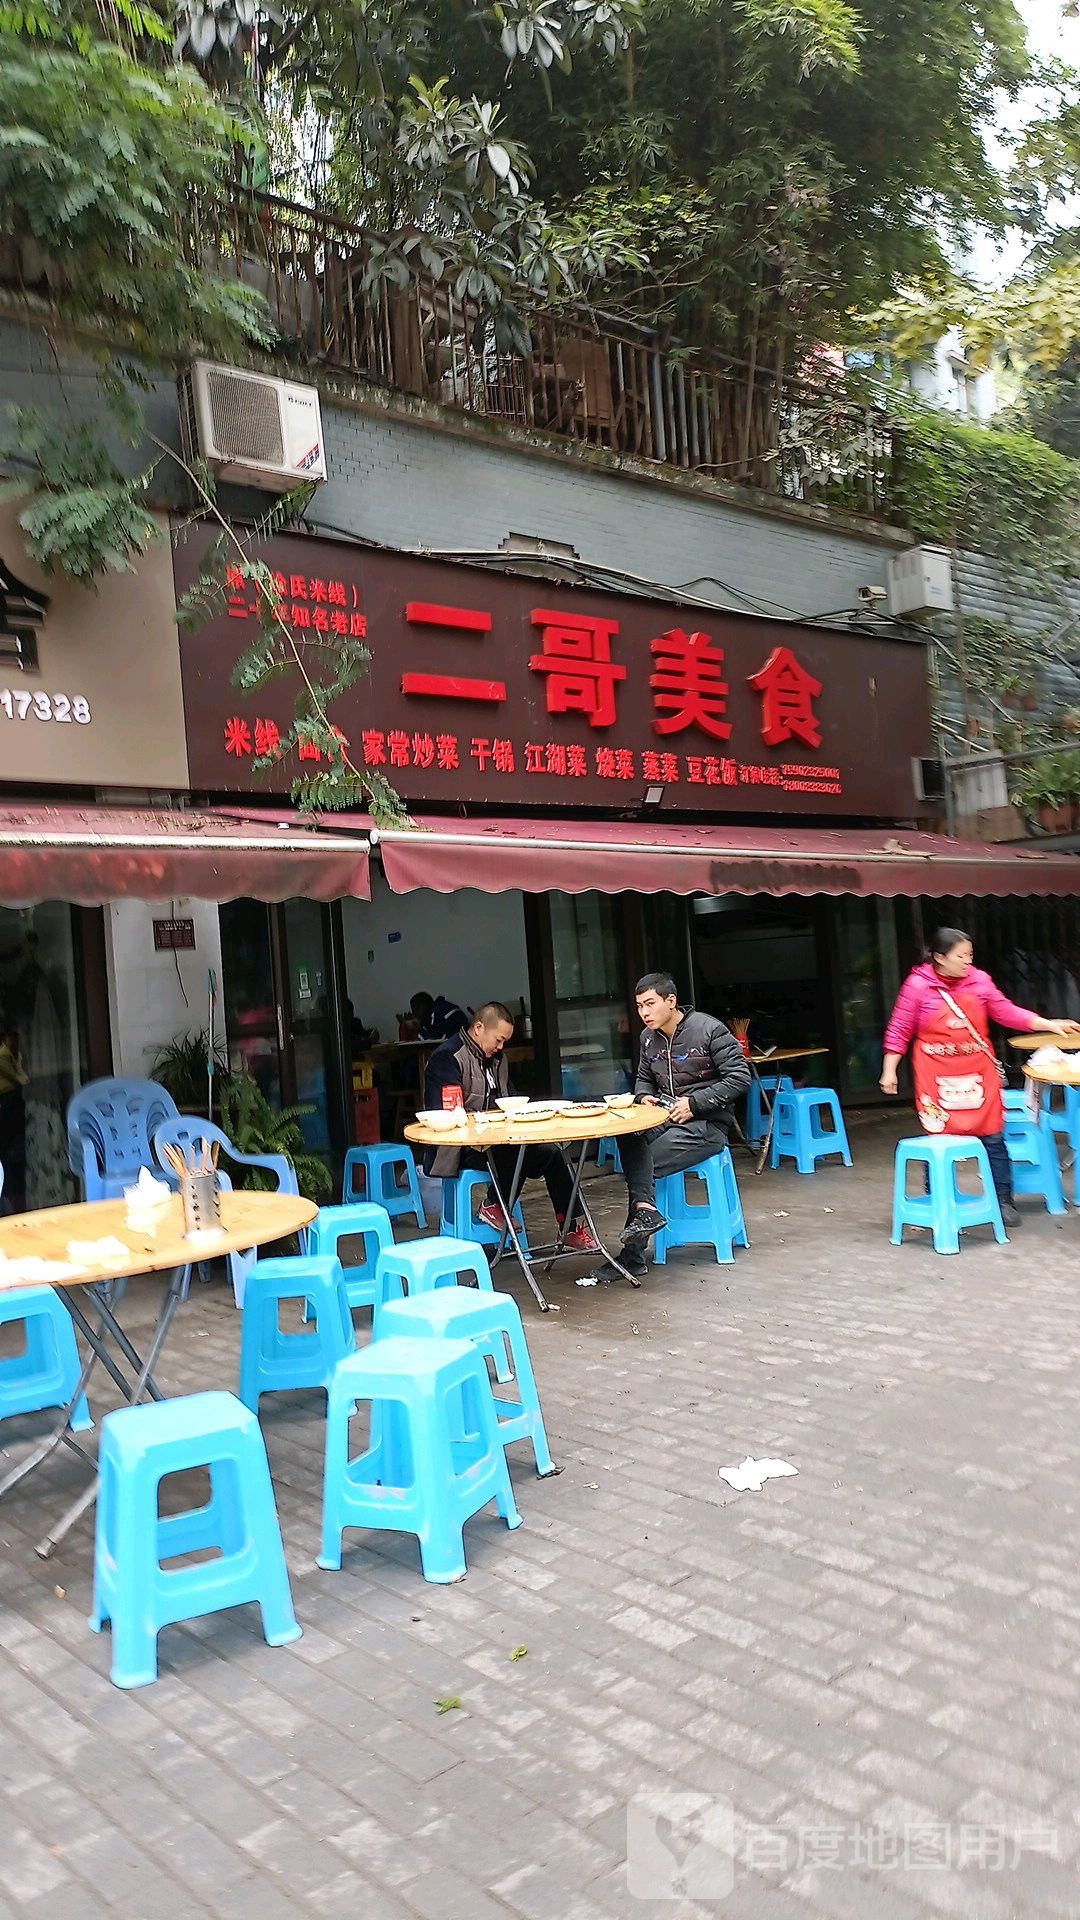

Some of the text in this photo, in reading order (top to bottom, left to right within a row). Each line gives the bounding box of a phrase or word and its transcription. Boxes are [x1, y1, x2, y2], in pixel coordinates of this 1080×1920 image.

[0, 688, 92, 725] 17328
[400, 601, 823, 750] 二哥美食
[224, 716, 283, 760] 米线
[361, 728, 460, 771] 家常炒菜
[470, 737, 516, 773] 干锅
[524, 741, 588, 777] 江湖菜
[595, 747, 635, 780] 烧菜
[641, 750, 680, 782] 蒸菜
[686, 755, 738, 787] 豆花饭
